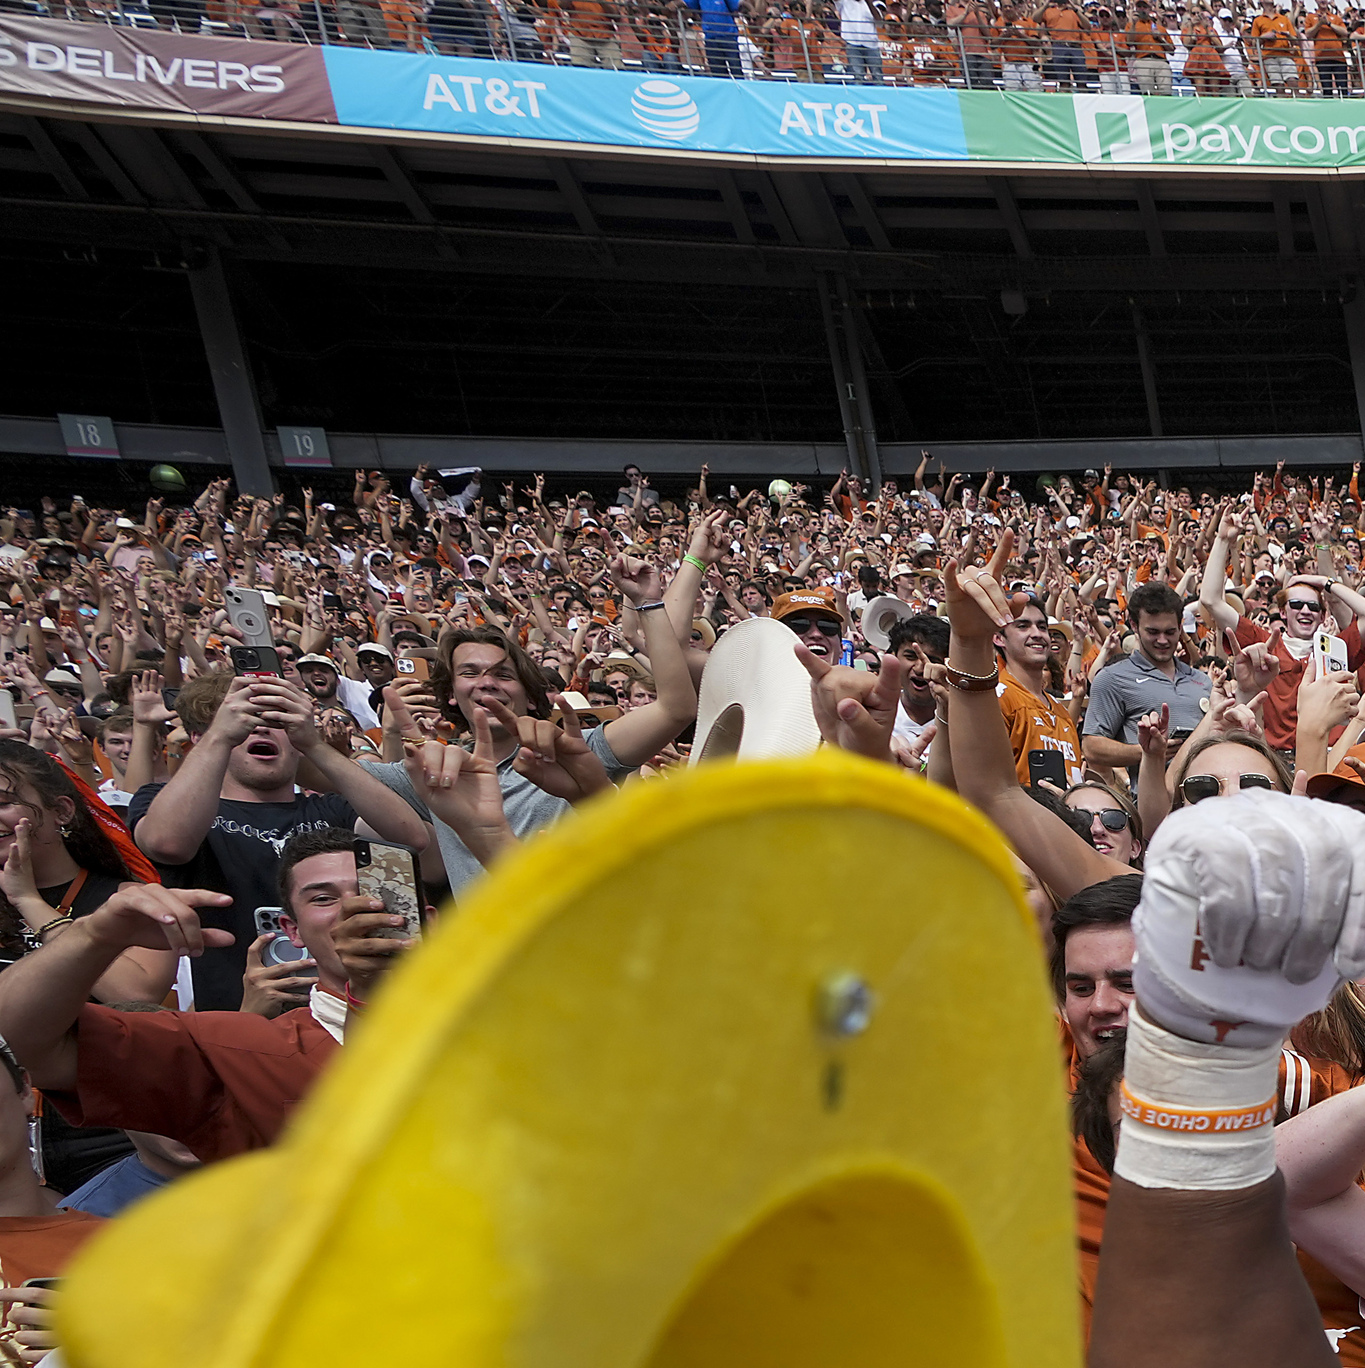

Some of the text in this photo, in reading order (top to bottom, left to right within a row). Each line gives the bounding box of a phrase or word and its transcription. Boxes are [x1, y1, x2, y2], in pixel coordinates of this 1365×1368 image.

[26, 41, 286, 94] DELIVERS
[422, 73, 546, 118] AT&T
[779, 101, 888, 138] AT&T
[76, 422, 101, 447] 18
[293, 434, 315, 457] 19
[1039, 734, 1077, 762] TEXAS
[1146, 1109, 1210, 1131] CHLOE
[1215, 1108, 1263, 1131] TEAM
